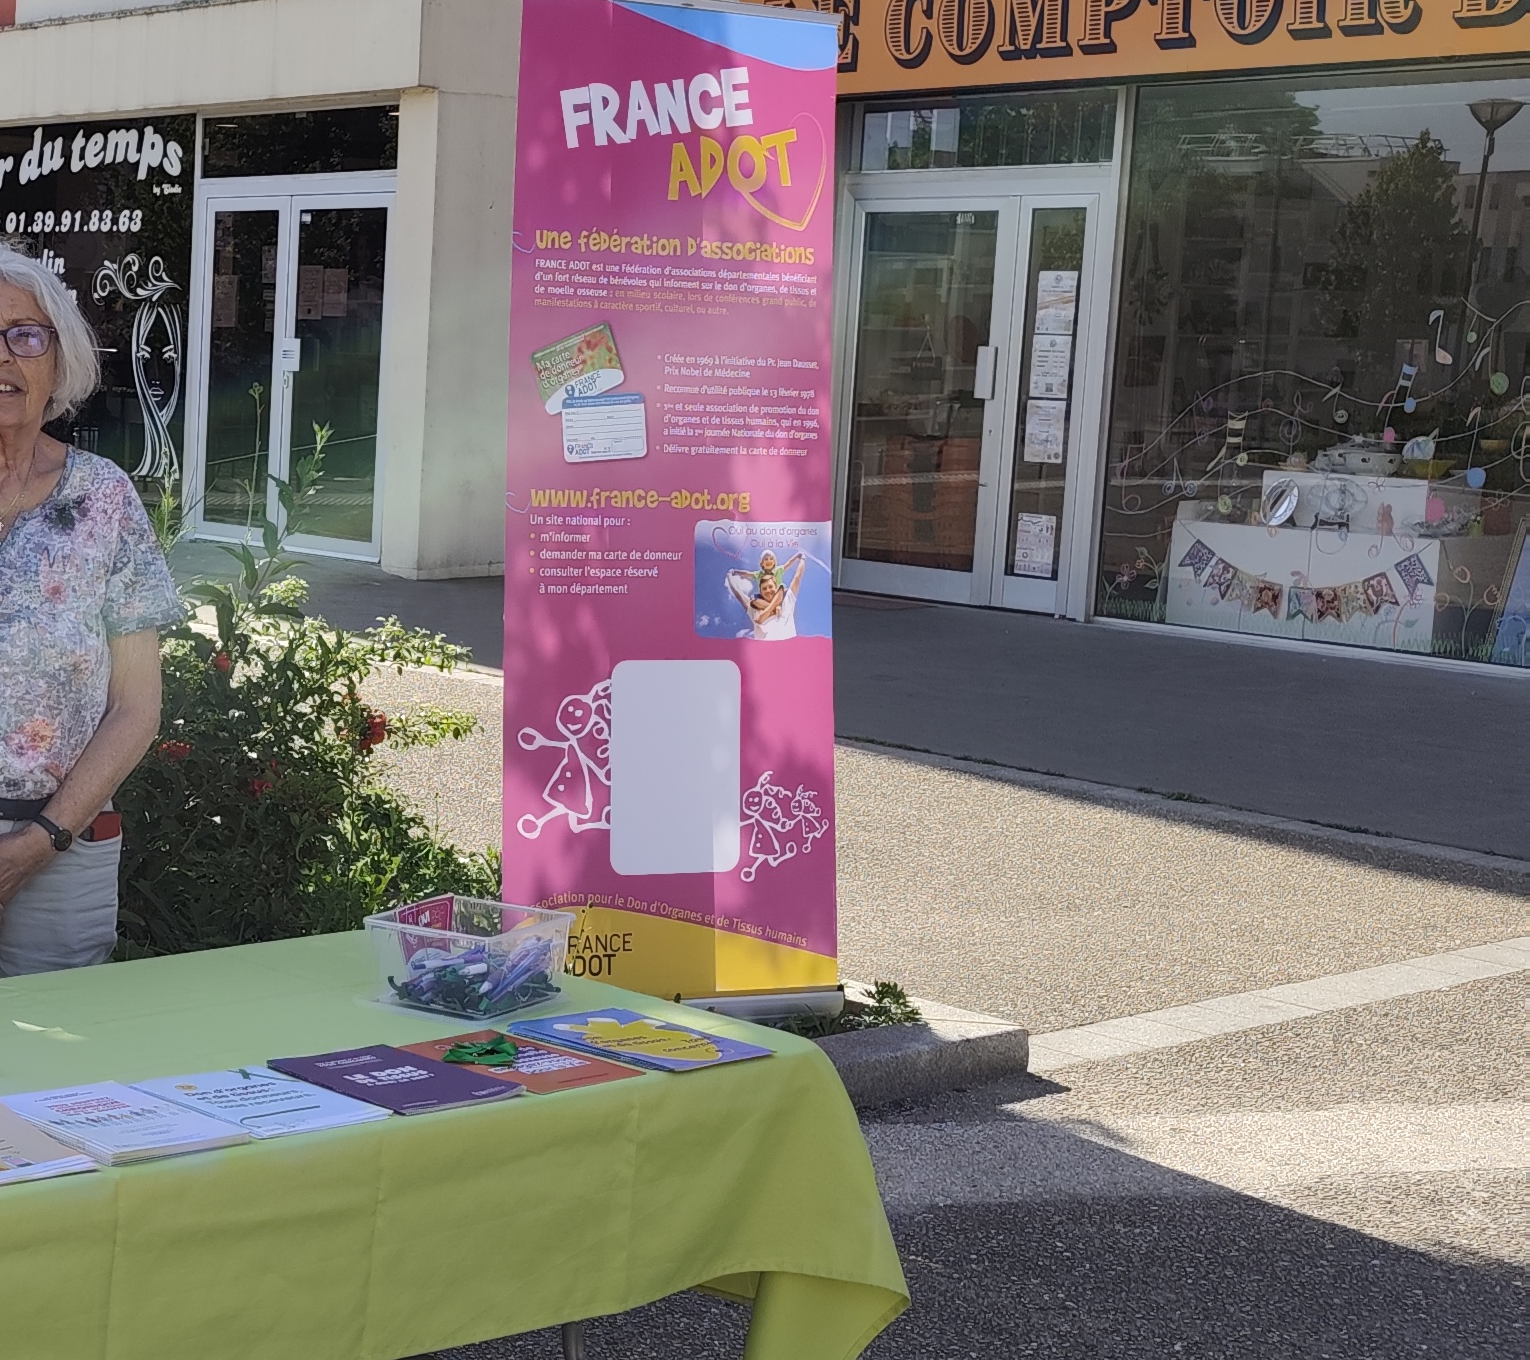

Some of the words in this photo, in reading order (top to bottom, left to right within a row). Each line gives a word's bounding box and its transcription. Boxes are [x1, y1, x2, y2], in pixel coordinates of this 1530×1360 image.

[560, 67, 754, 149] FRANCE
[19, 126, 66, 186] du
[70, 125, 183, 181] temps
[667, 128, 798, 201] ADOT
[5, 209, 143, 234] 01.39.91.83.63
[535, 258, 566, 269] FRANCE
[568, 259, 590, 271] ADOT
[591, 261, 603, 271] est
[605, 264, 619, 272] une
[621, 262, 661, 275] Fédération
[663, 265, 716, 278] d'associations
[718, 268, 779, 283] départementales
[534, 270, 552, 281] d'un
[555, 271, 569, 282] fort
[571, 272, 596, 283] réseau
[598, 274, 608, 284] de
[609, 274, 647, 286] bénévoles
[649, 277, 661, 288] qui
[663, 277, 699, 289] informent
[700, 282, 713, 290] sur
[714, 280, 721, 291] le
[723, 281, 737, 292] don
[779, 284, 788, 294] de
[534, 283, 544, 293] de
[547, 284, 574, 295] moelle
[576, 288, 607, 297] osseuse
[615, 290, 624, 298] en
[703, 293, 712, 303] de
[756, 357, 766, 366] du
[664, 365, 678, 375] Prix
[680, 366, 701, 376] Nobel
[703, 367, 712, 376] de
[714, 367, 750, 377] Médecine
[574, 370, 602, 388] FRANCE
[578, 382, 598, 397] ADOT
[728, 386, 760, 398] publique
[761, 387, 768, 396] le
[705, 403, 747, 413] association
[748, 404, 758, 413] de
[710, 415, 720, 424] de
[764, 429, 774, 438] du
[774, 429, 787, 438] don
[690, 444, 737, 456] gratuitement
[739, 445, 746, 454] la
[748, 445, 767, 455] carte
[768, 446, 775, 455] de
[529, 513, 543, 524] Un
[545, 514, 562, 525] site
[565, 514, 601, 525] national
[603, 517, 625, 528] pour
[539, 531, 590, 542] m'informer
[728, 524, 744, 534] Oui
[745, 527, 757, 535] au
[759, 525, 776, 536] don
[778, 526, 817, 539] d'organes
[776, 538, 783, 548] la
[539, 548, 585, 559] demander
[588, 551, 602, 560] ma
[603, 549, 627, 560] carte
[629, 550, 641, 561] de
[643, 550, 682, 562] donneur
[539, 565, 582, 576] consulter
[584, 566, 620, 579] l'espace
[624, 567, 658, 578] réservé
[547, 584, 567, 593] mon
[569, 582, 628, 597] département
[587, 892, 613, 906] pour
[615, 894, 624, 906] le
[626, 897, 648, 911] Don
[650, 900, 702, 922] d'Organes
[704, 914, 715, 925] et
[717, 914, 730, 928] de
[733, 918, 763, 936] Tissus
[765, 925, 808, 947] humains
[567, 933, 633, 955] RANCE
